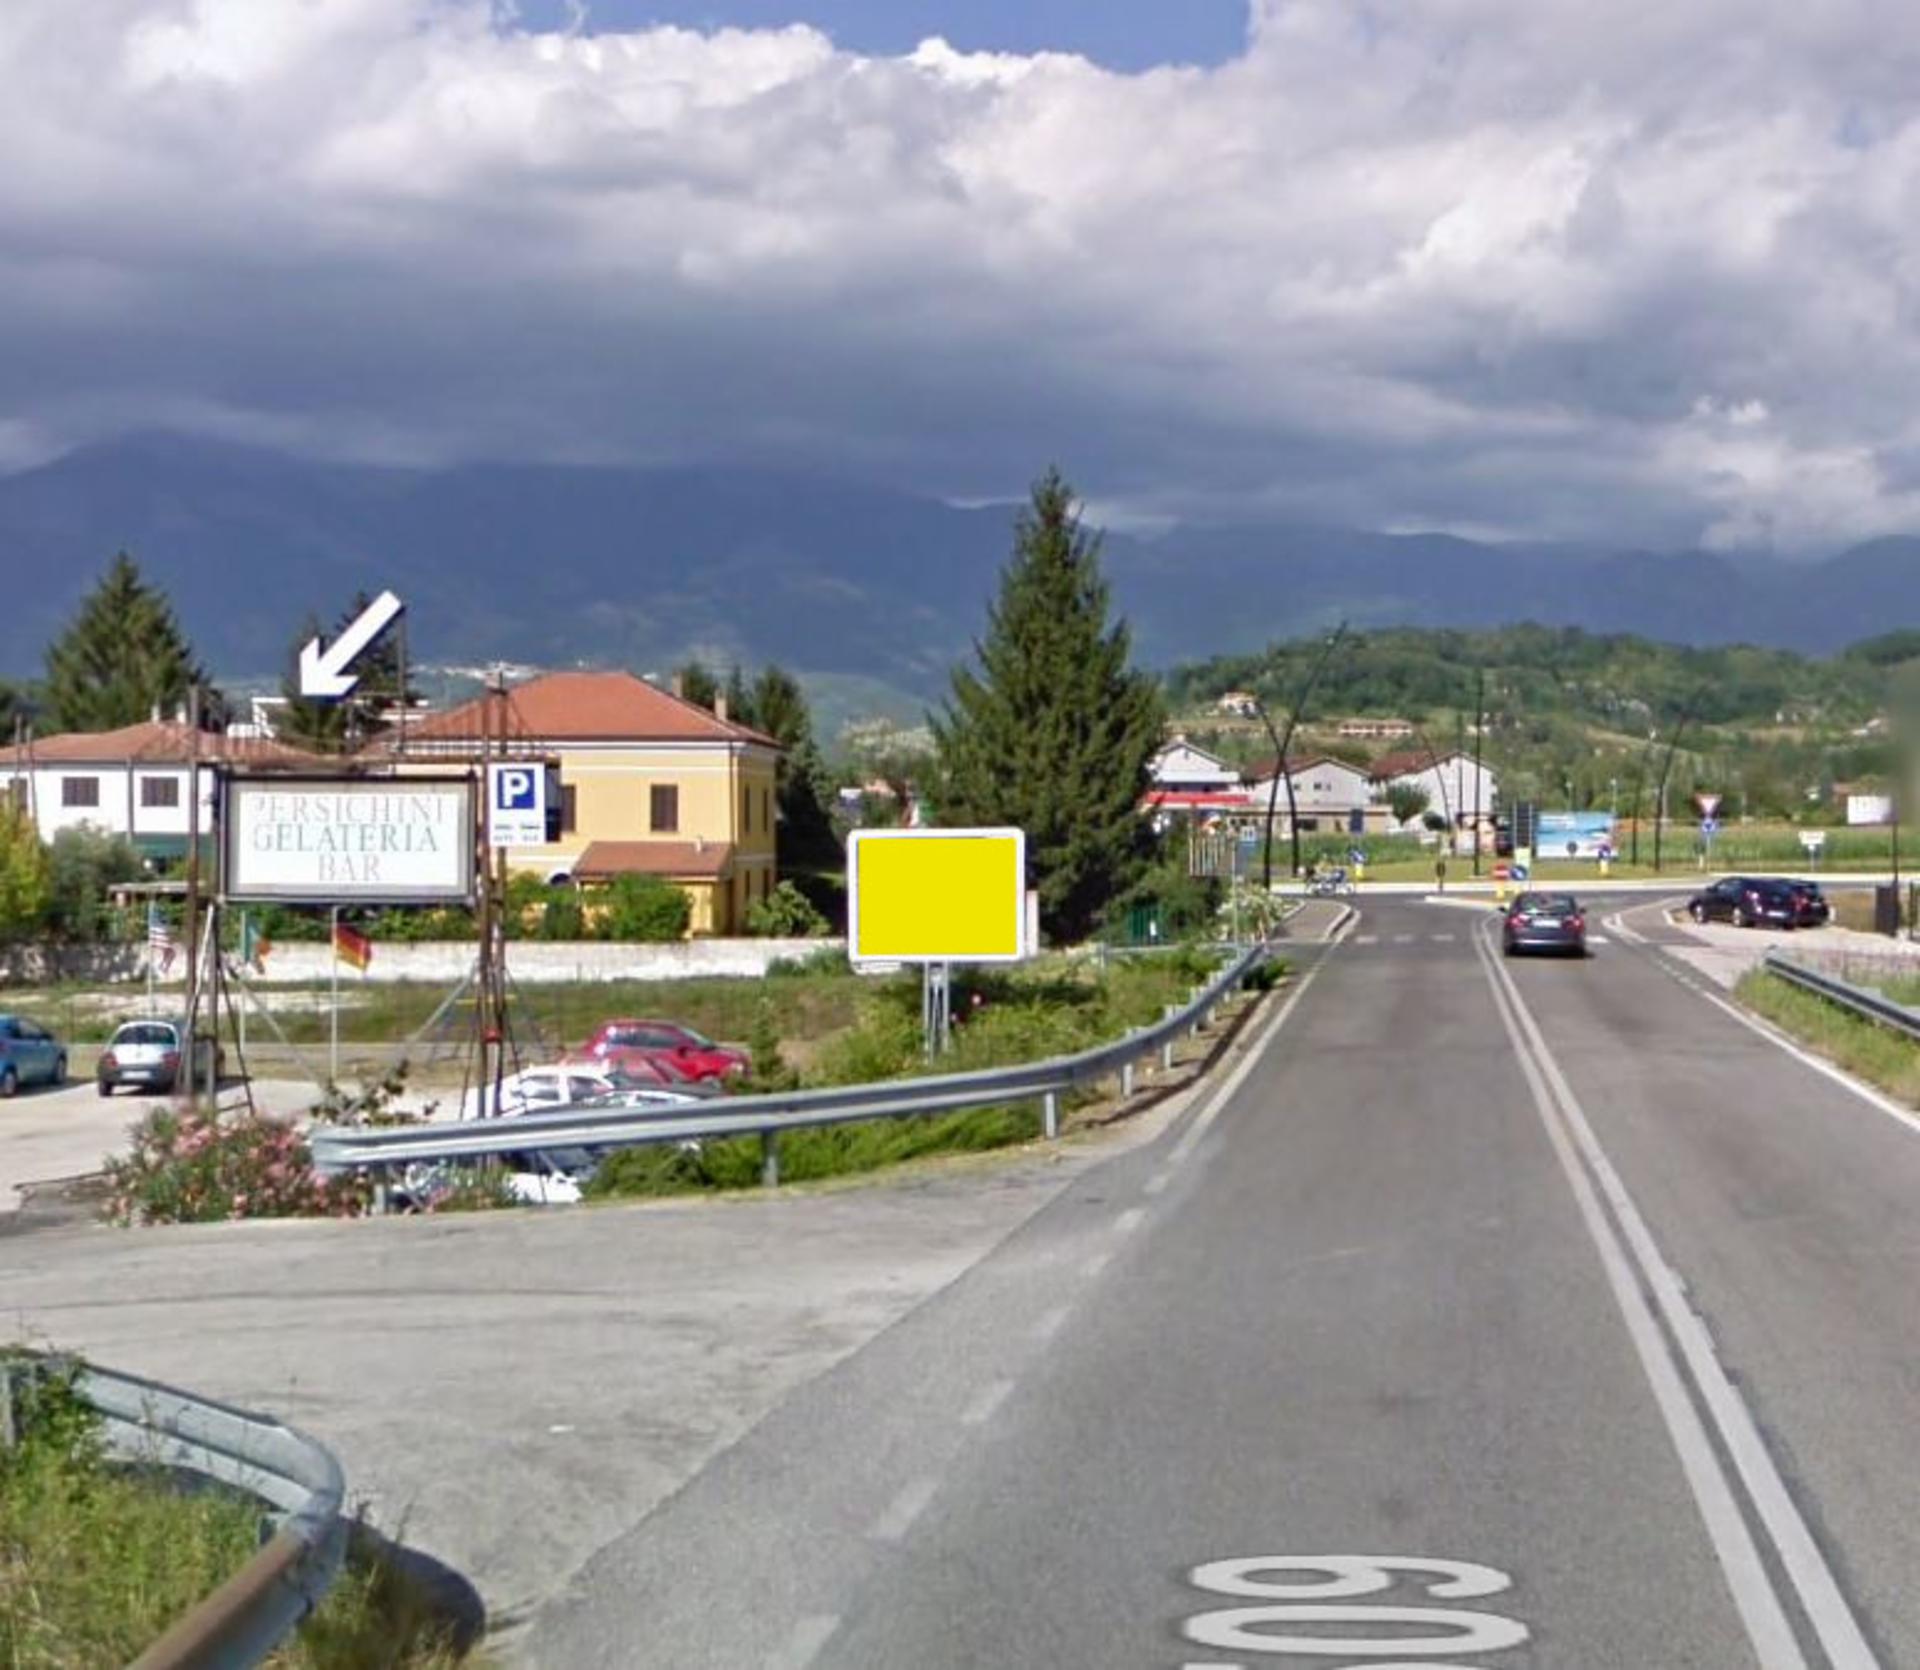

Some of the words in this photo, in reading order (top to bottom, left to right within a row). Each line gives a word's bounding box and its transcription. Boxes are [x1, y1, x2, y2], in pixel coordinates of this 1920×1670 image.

[502, 771, 530, 807] P
[252, 796, 445, 823] PERSICHINI
[253, 823, 440, 852] GELATERIA
[319, 853, 380, 882] BAR
